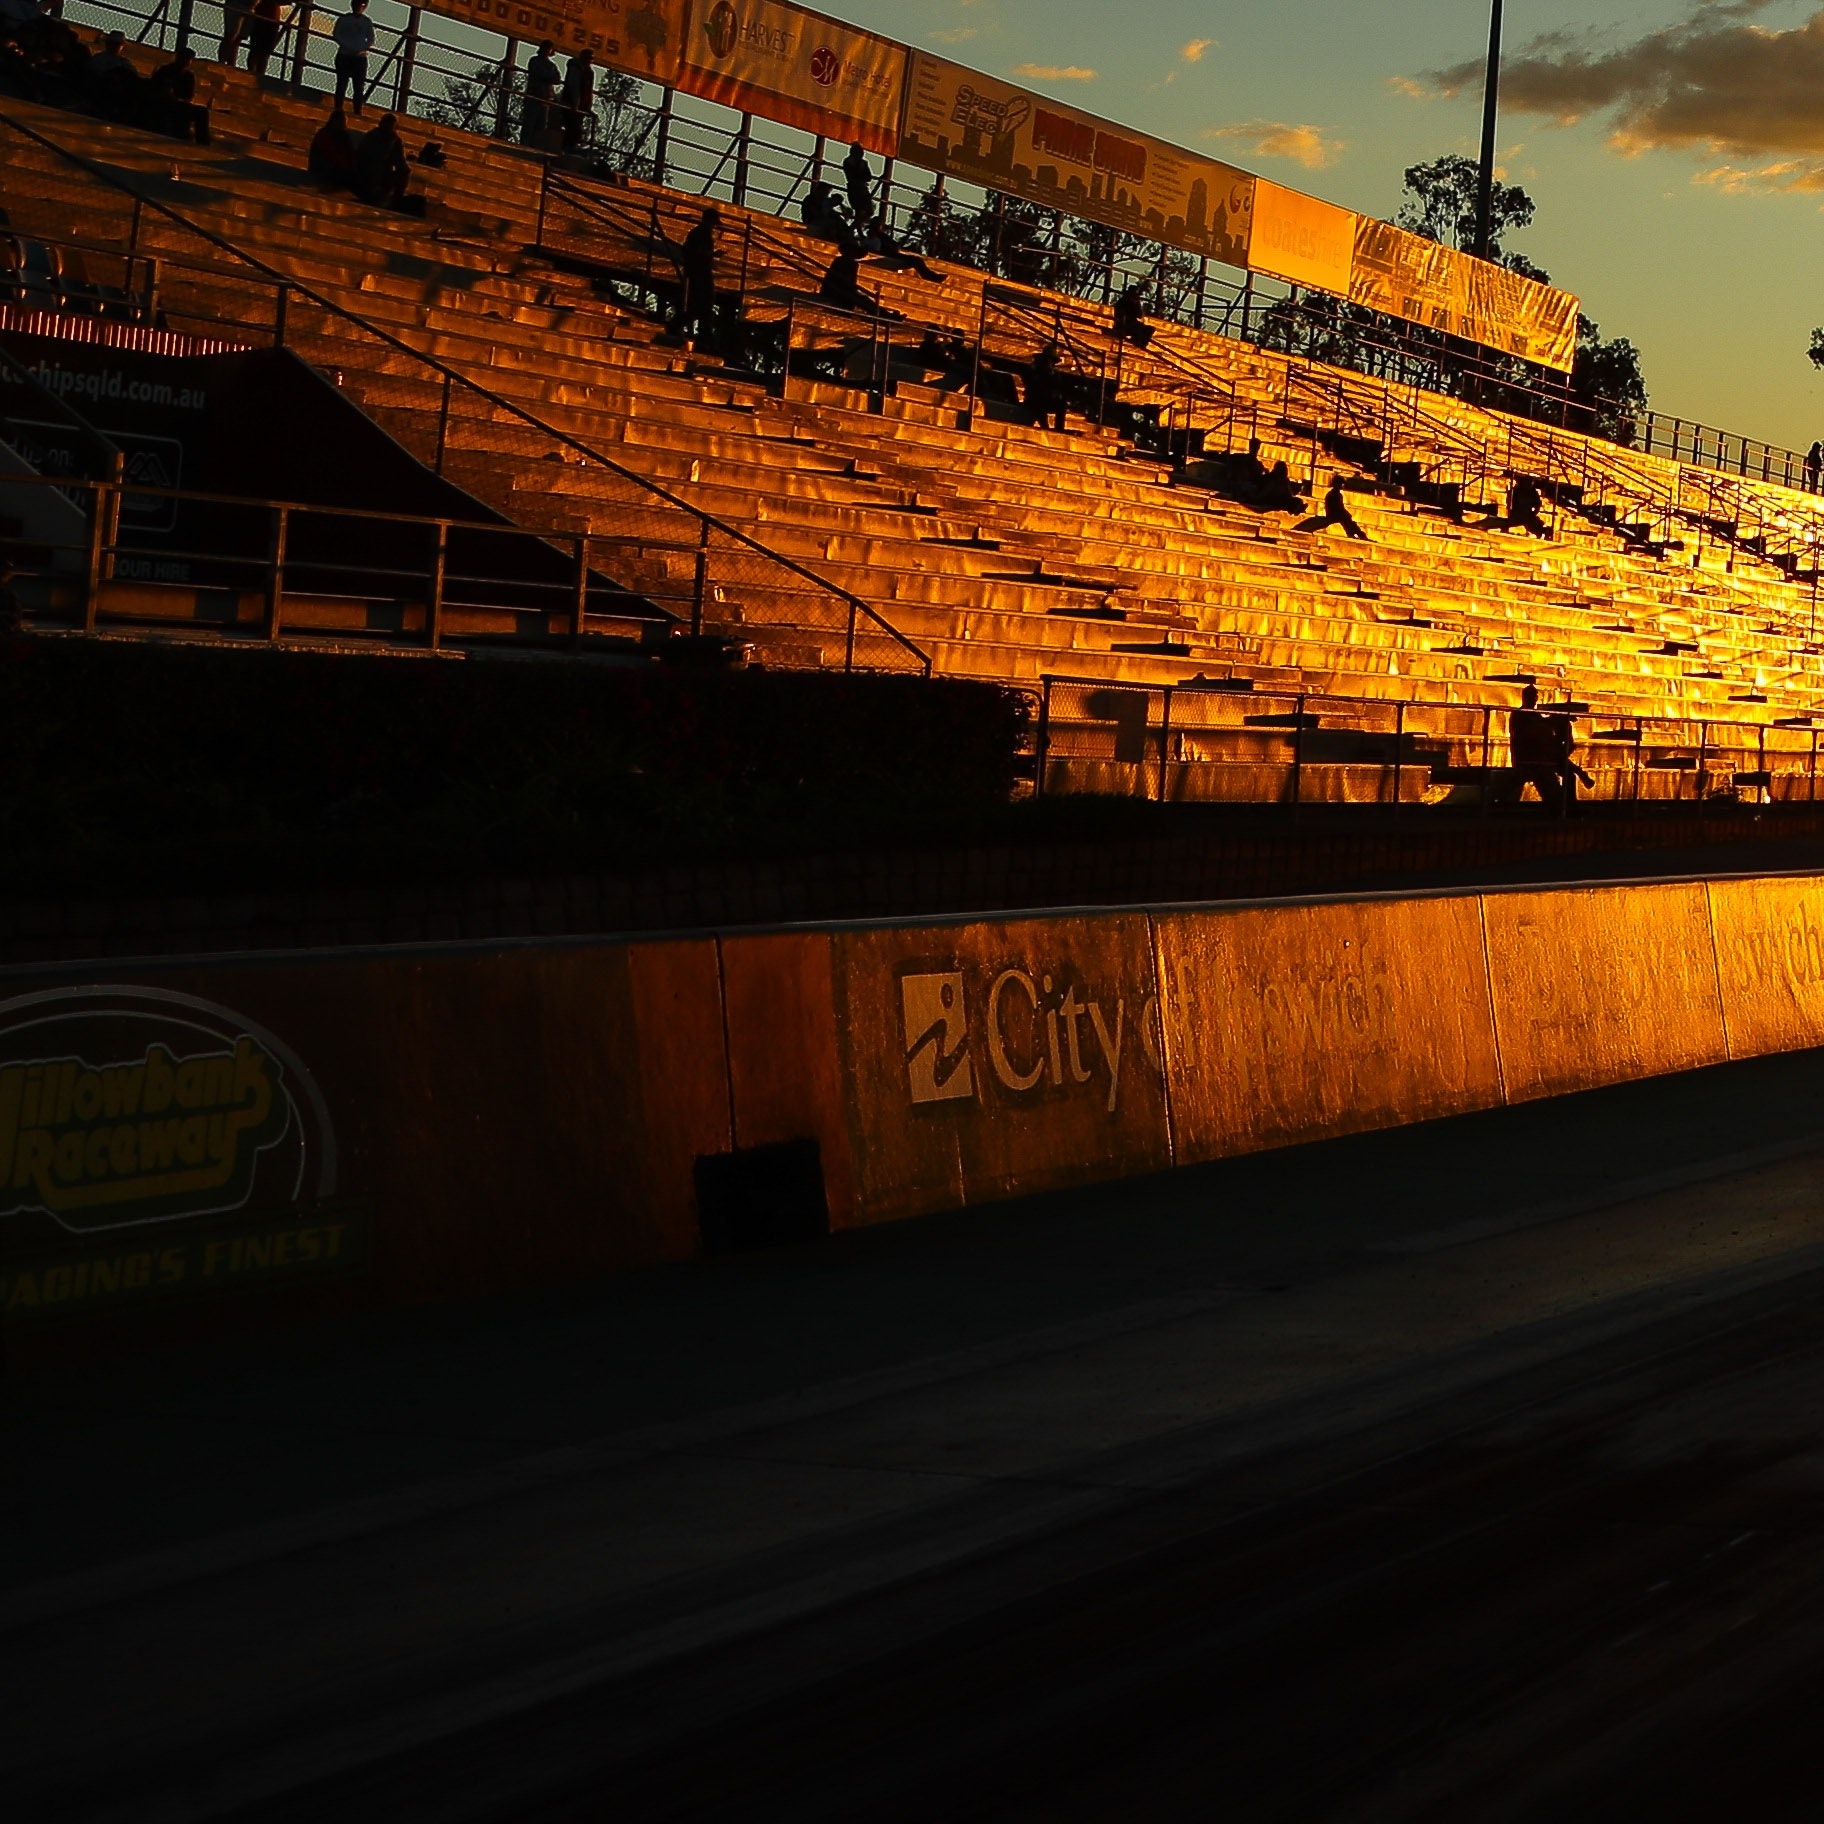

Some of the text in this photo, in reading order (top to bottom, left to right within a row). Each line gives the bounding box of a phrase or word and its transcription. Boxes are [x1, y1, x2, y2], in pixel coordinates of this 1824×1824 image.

[517, 9, 565, 37] 004
[740, 21, 796, 53] HARVEST
[987, 968, 1124, 1113] City
[0, 1224, 349, 1313] ACING'S FINEST
